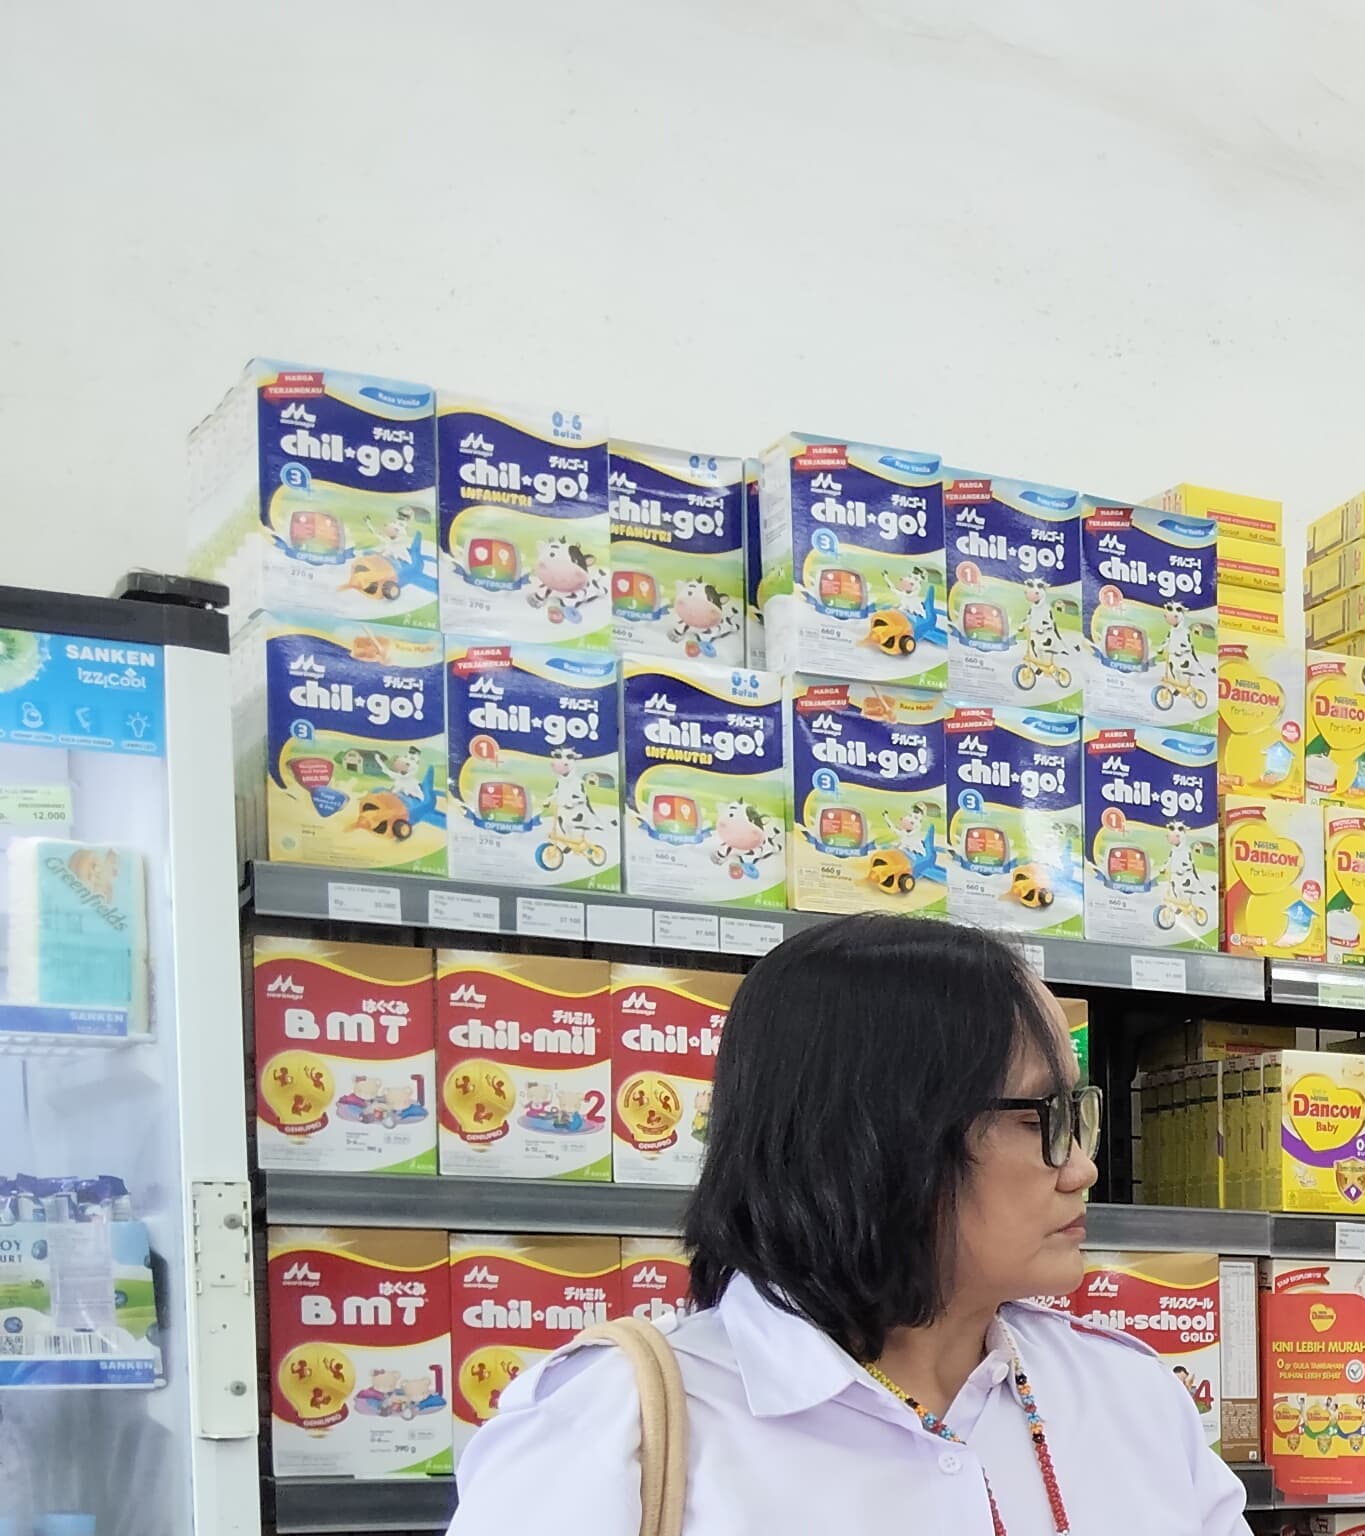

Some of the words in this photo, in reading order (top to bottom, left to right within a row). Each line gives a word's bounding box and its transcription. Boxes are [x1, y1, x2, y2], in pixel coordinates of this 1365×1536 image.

[460, 487, 532, 507] INFANUTRI
[66, 645, 155, 666] SANKEN
[44, 856, 128, 932] Greenfields
[583, 1089, 606, 1123] 2
[1180, 1332, 1214, 1343] GOLD
[1272, 1342, 1293, 1352] KINI
[1296, 1342, 1325, 1352] LEBIH
